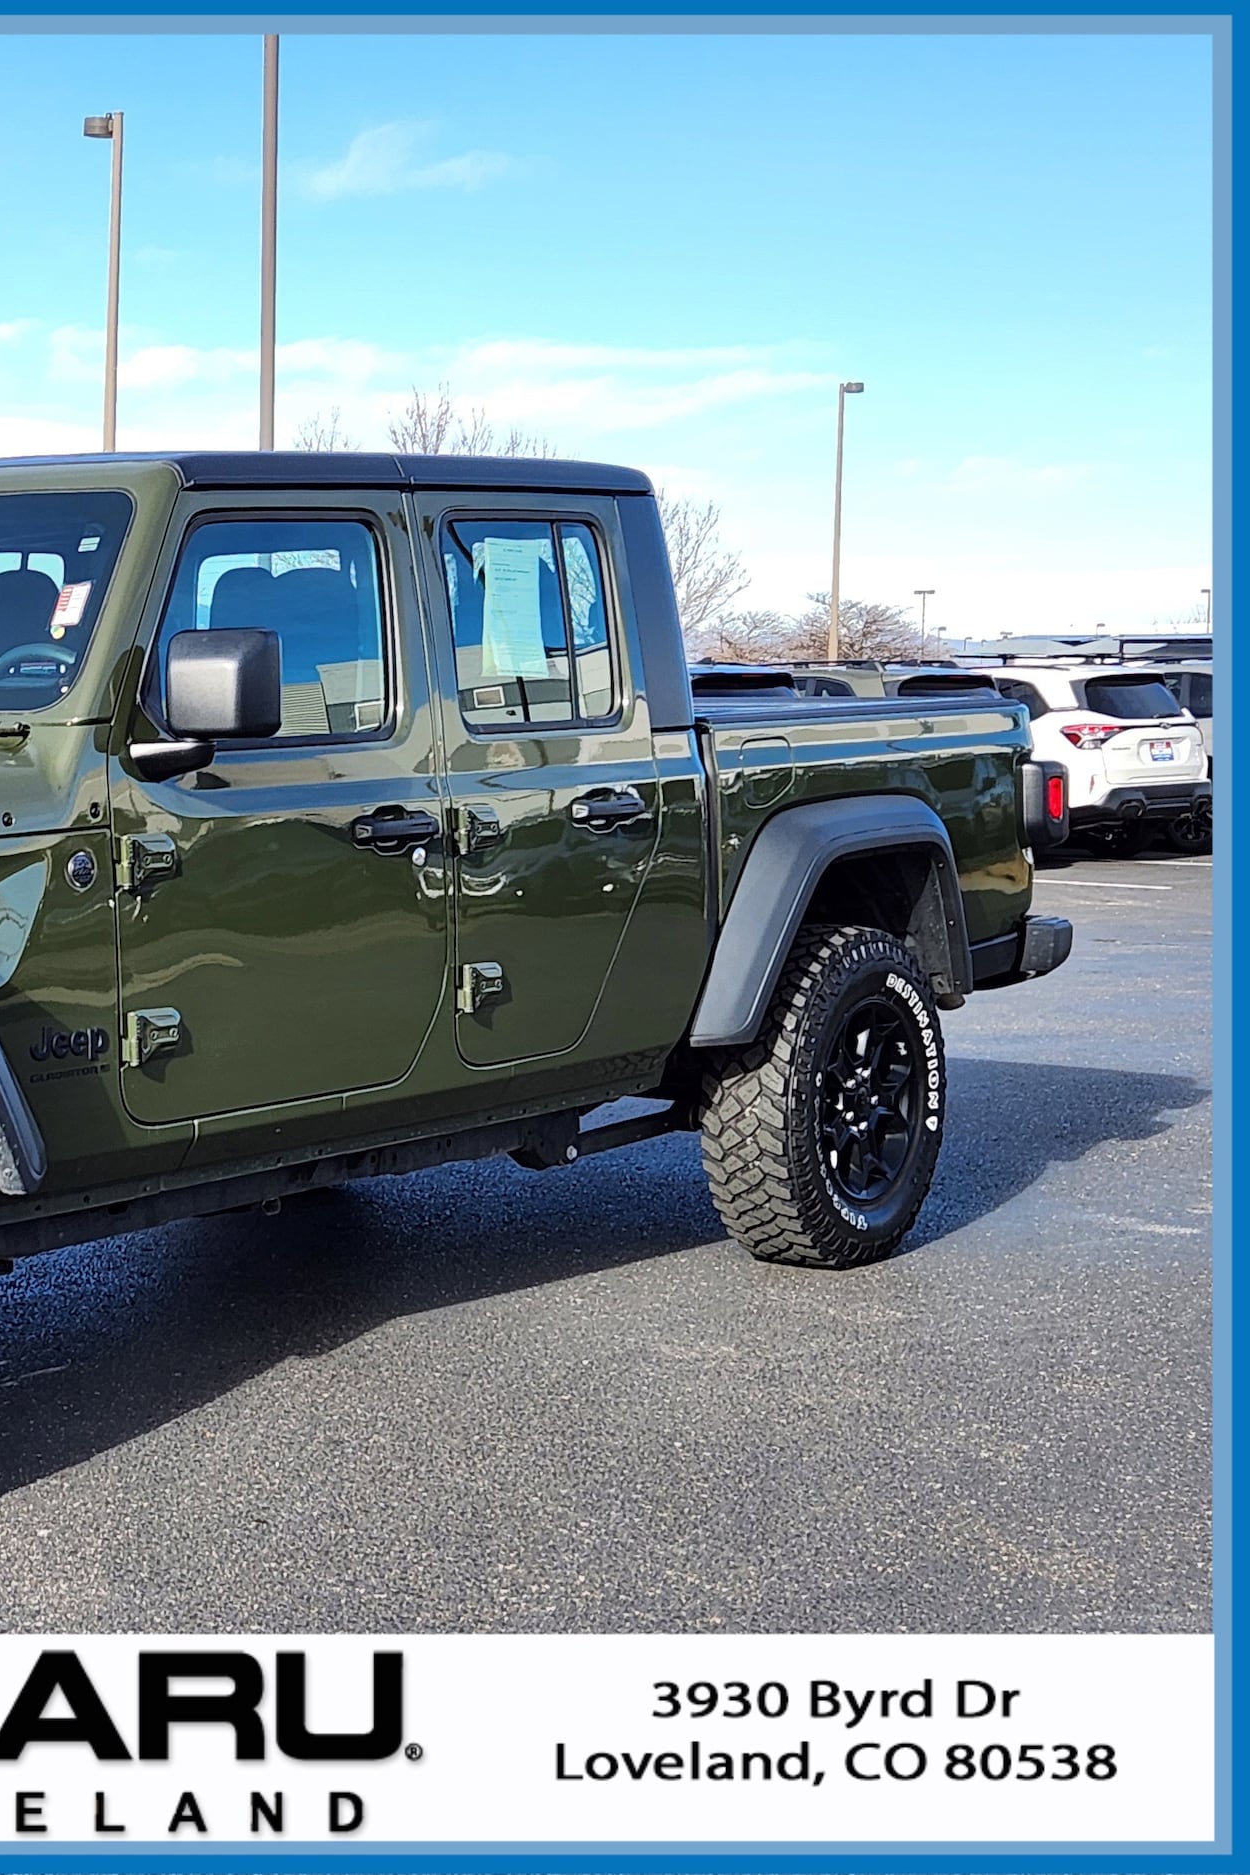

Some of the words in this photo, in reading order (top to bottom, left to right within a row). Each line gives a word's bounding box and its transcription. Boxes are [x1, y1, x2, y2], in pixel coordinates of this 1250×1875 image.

[29, 1025, 111, 1062] Jeep
[885, 972, 940, 1110] DESTINATION
[30, 1064, 99, 1084] GLADIATOR
